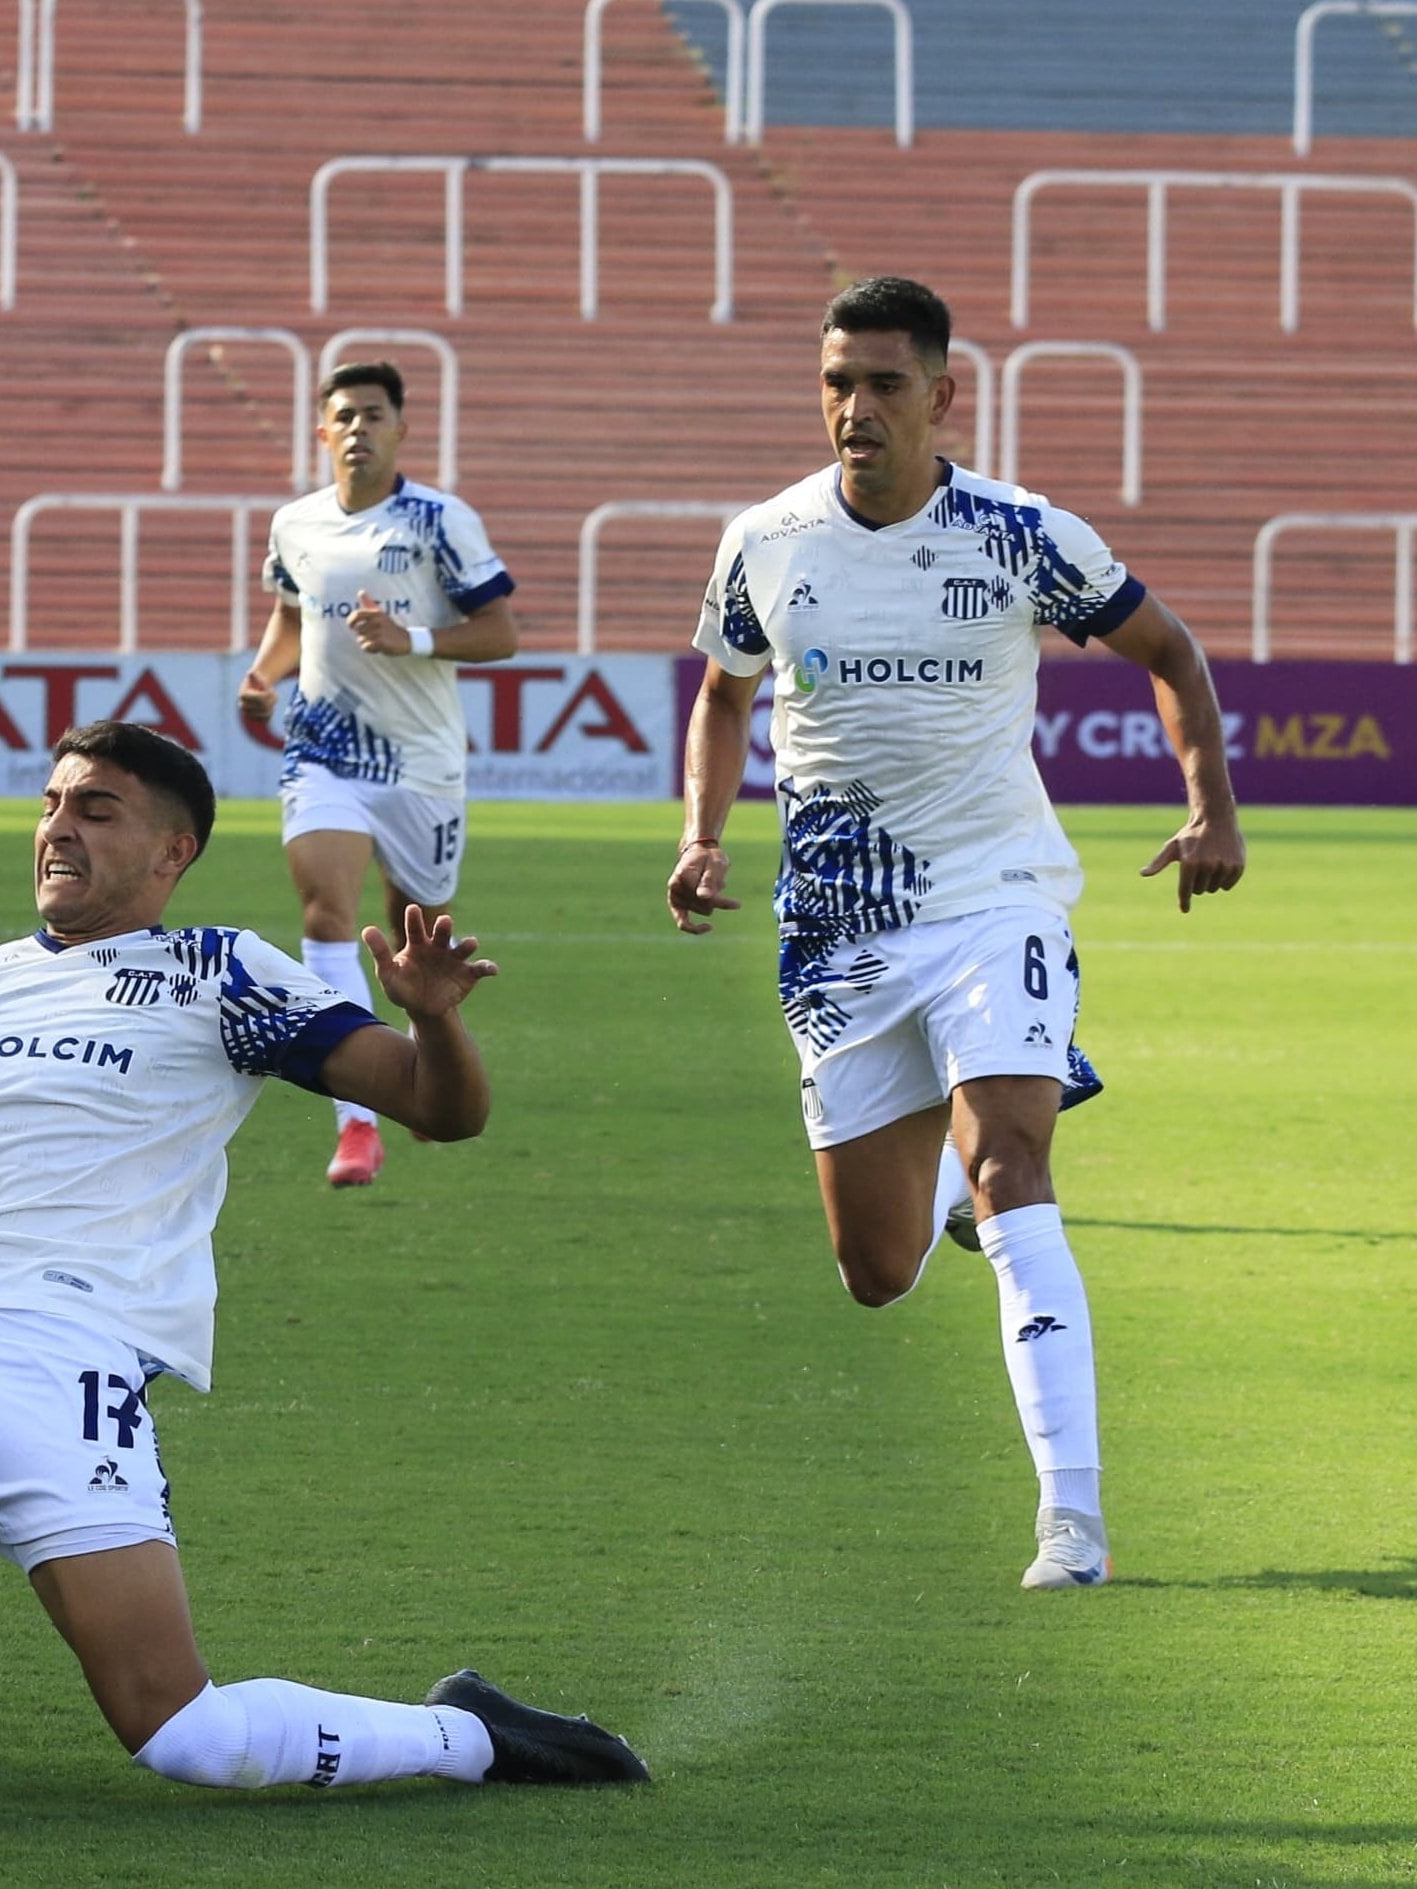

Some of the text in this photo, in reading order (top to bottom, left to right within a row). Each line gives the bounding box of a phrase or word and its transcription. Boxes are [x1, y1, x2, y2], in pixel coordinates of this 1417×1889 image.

[760, 517, 826, 543] ADVANTA
[322, 599, 411, 619] HOIM
[839, 658, 983, 685] HOLCIM
[1076, 712, 1245, 758] CRZ
[1255, 714, 1390, 759] MZA
[434, 818, 459, 865] 15
[1024, 935, 1048, 1000] 6
[79, 1370, 142, 1449] 17
